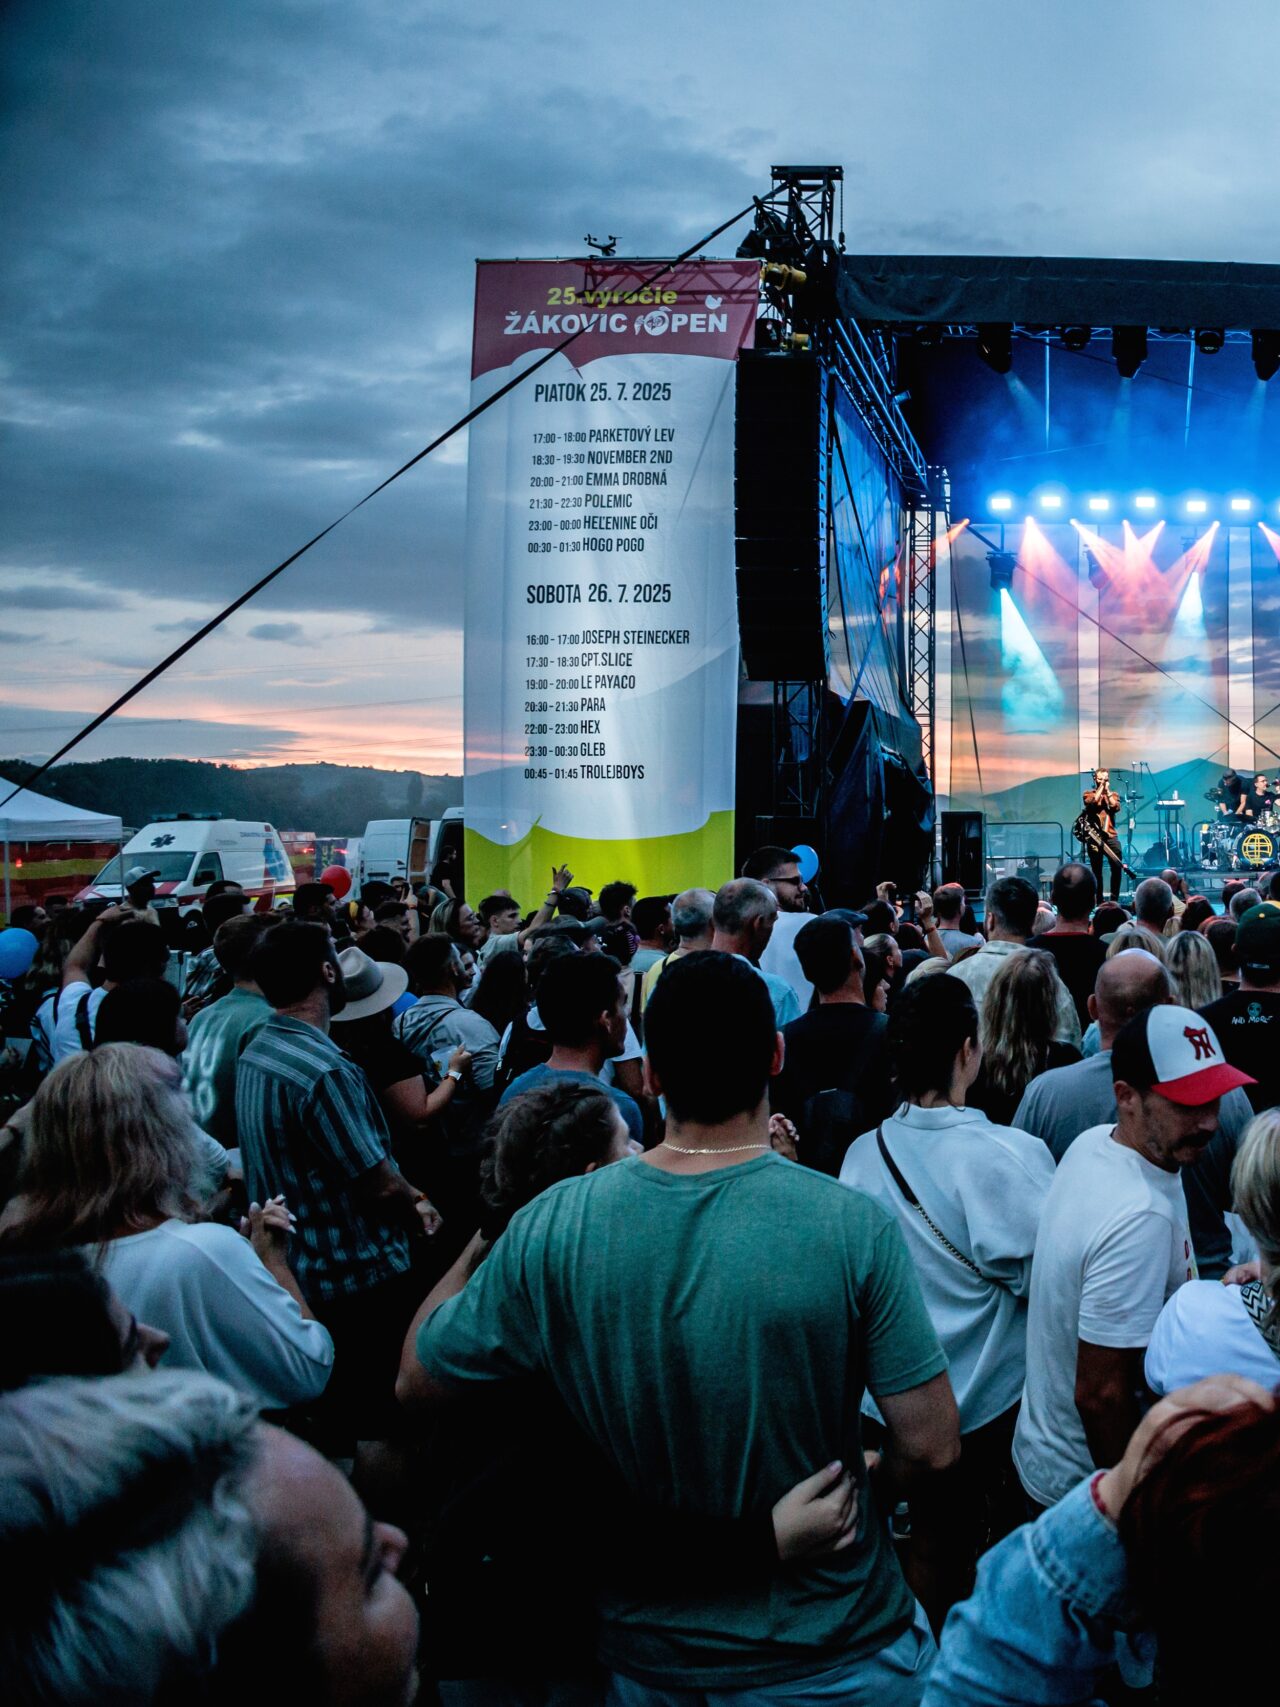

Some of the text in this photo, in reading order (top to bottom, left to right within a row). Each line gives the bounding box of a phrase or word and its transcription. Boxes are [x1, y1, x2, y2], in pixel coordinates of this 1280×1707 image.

[504, 311, 627, 334] ŽÁKOVIC
[535, 383, 671, 402] PIATOK 25. 7. 2025
[533, 433, 556, 443] 17:00
[564, 432, 586, 442] 18:00
[589, 426, 651, 442] PARKETOVÝ
[654, 428, 674, 442] LEV
[532, 455, 554, 465] 18:30
[563, 454, 584, 464] 19:30
[588, 451, 646, 464] NOVEMBER
[650, 450, 672, 464] 2ND
[531, 477, 553, 487] 20:00
[562, 476, 583, 486] 21:00
[586, 472, 619, 486] EMMA
[623, 469, 667, 486] DROBNÁ
[530, 499, 552, 509] 21:30
[561, 498, 582, 508] 22:30
[585, 494, 632, 508] POLEMIC
[529, 520, 552, 530] 23:00
[560, 519, 581, 530] 00:00
[640, 512, 657, 529] OČI
[528, 542, 550, 552] 00:30
[560, 542, 580, 552] 01:30
[582, 538, 612, 551] HOGO
[616, 538, 644, 551] POGO
[527, 584, 671, 604] SOBOTA 26. 7. 2025
[526, 635, 548, 645] 16:00
[558, 634, 579, 644] 17:00
[582, 630, 620, 644] JOSEPH
[624, 630, 690, 644] STEINECKER
[526, 657, 548, 667] 17:30
[557, 656, 579, 667] 18:30
[526, 680, 548, 689] 19:00
[556, 679, 578, 689] 20:00
[581, 675, 592, 689] LE
[595, 675, 636, 689] PAYACO
[525, 702, 548, 712] 20:30
[556, 701, 578, 712] 21:30
[581, 698, 606, 711] PARA
[525, 724, 548, 734] 22:00
[555, 724, 578, 734] 23:00
[581, 720, 600, 734] HEX
[525, 746, 547, 756] 23:30
[554, 746, 578, 756] 00:30
[580, 743, 606, 756] GLEB
[525, 768, 547, 779] 00:45
[554, 768, 578, 778] 01:45
[580, 765, 644, 779] TROLEJBOYS
